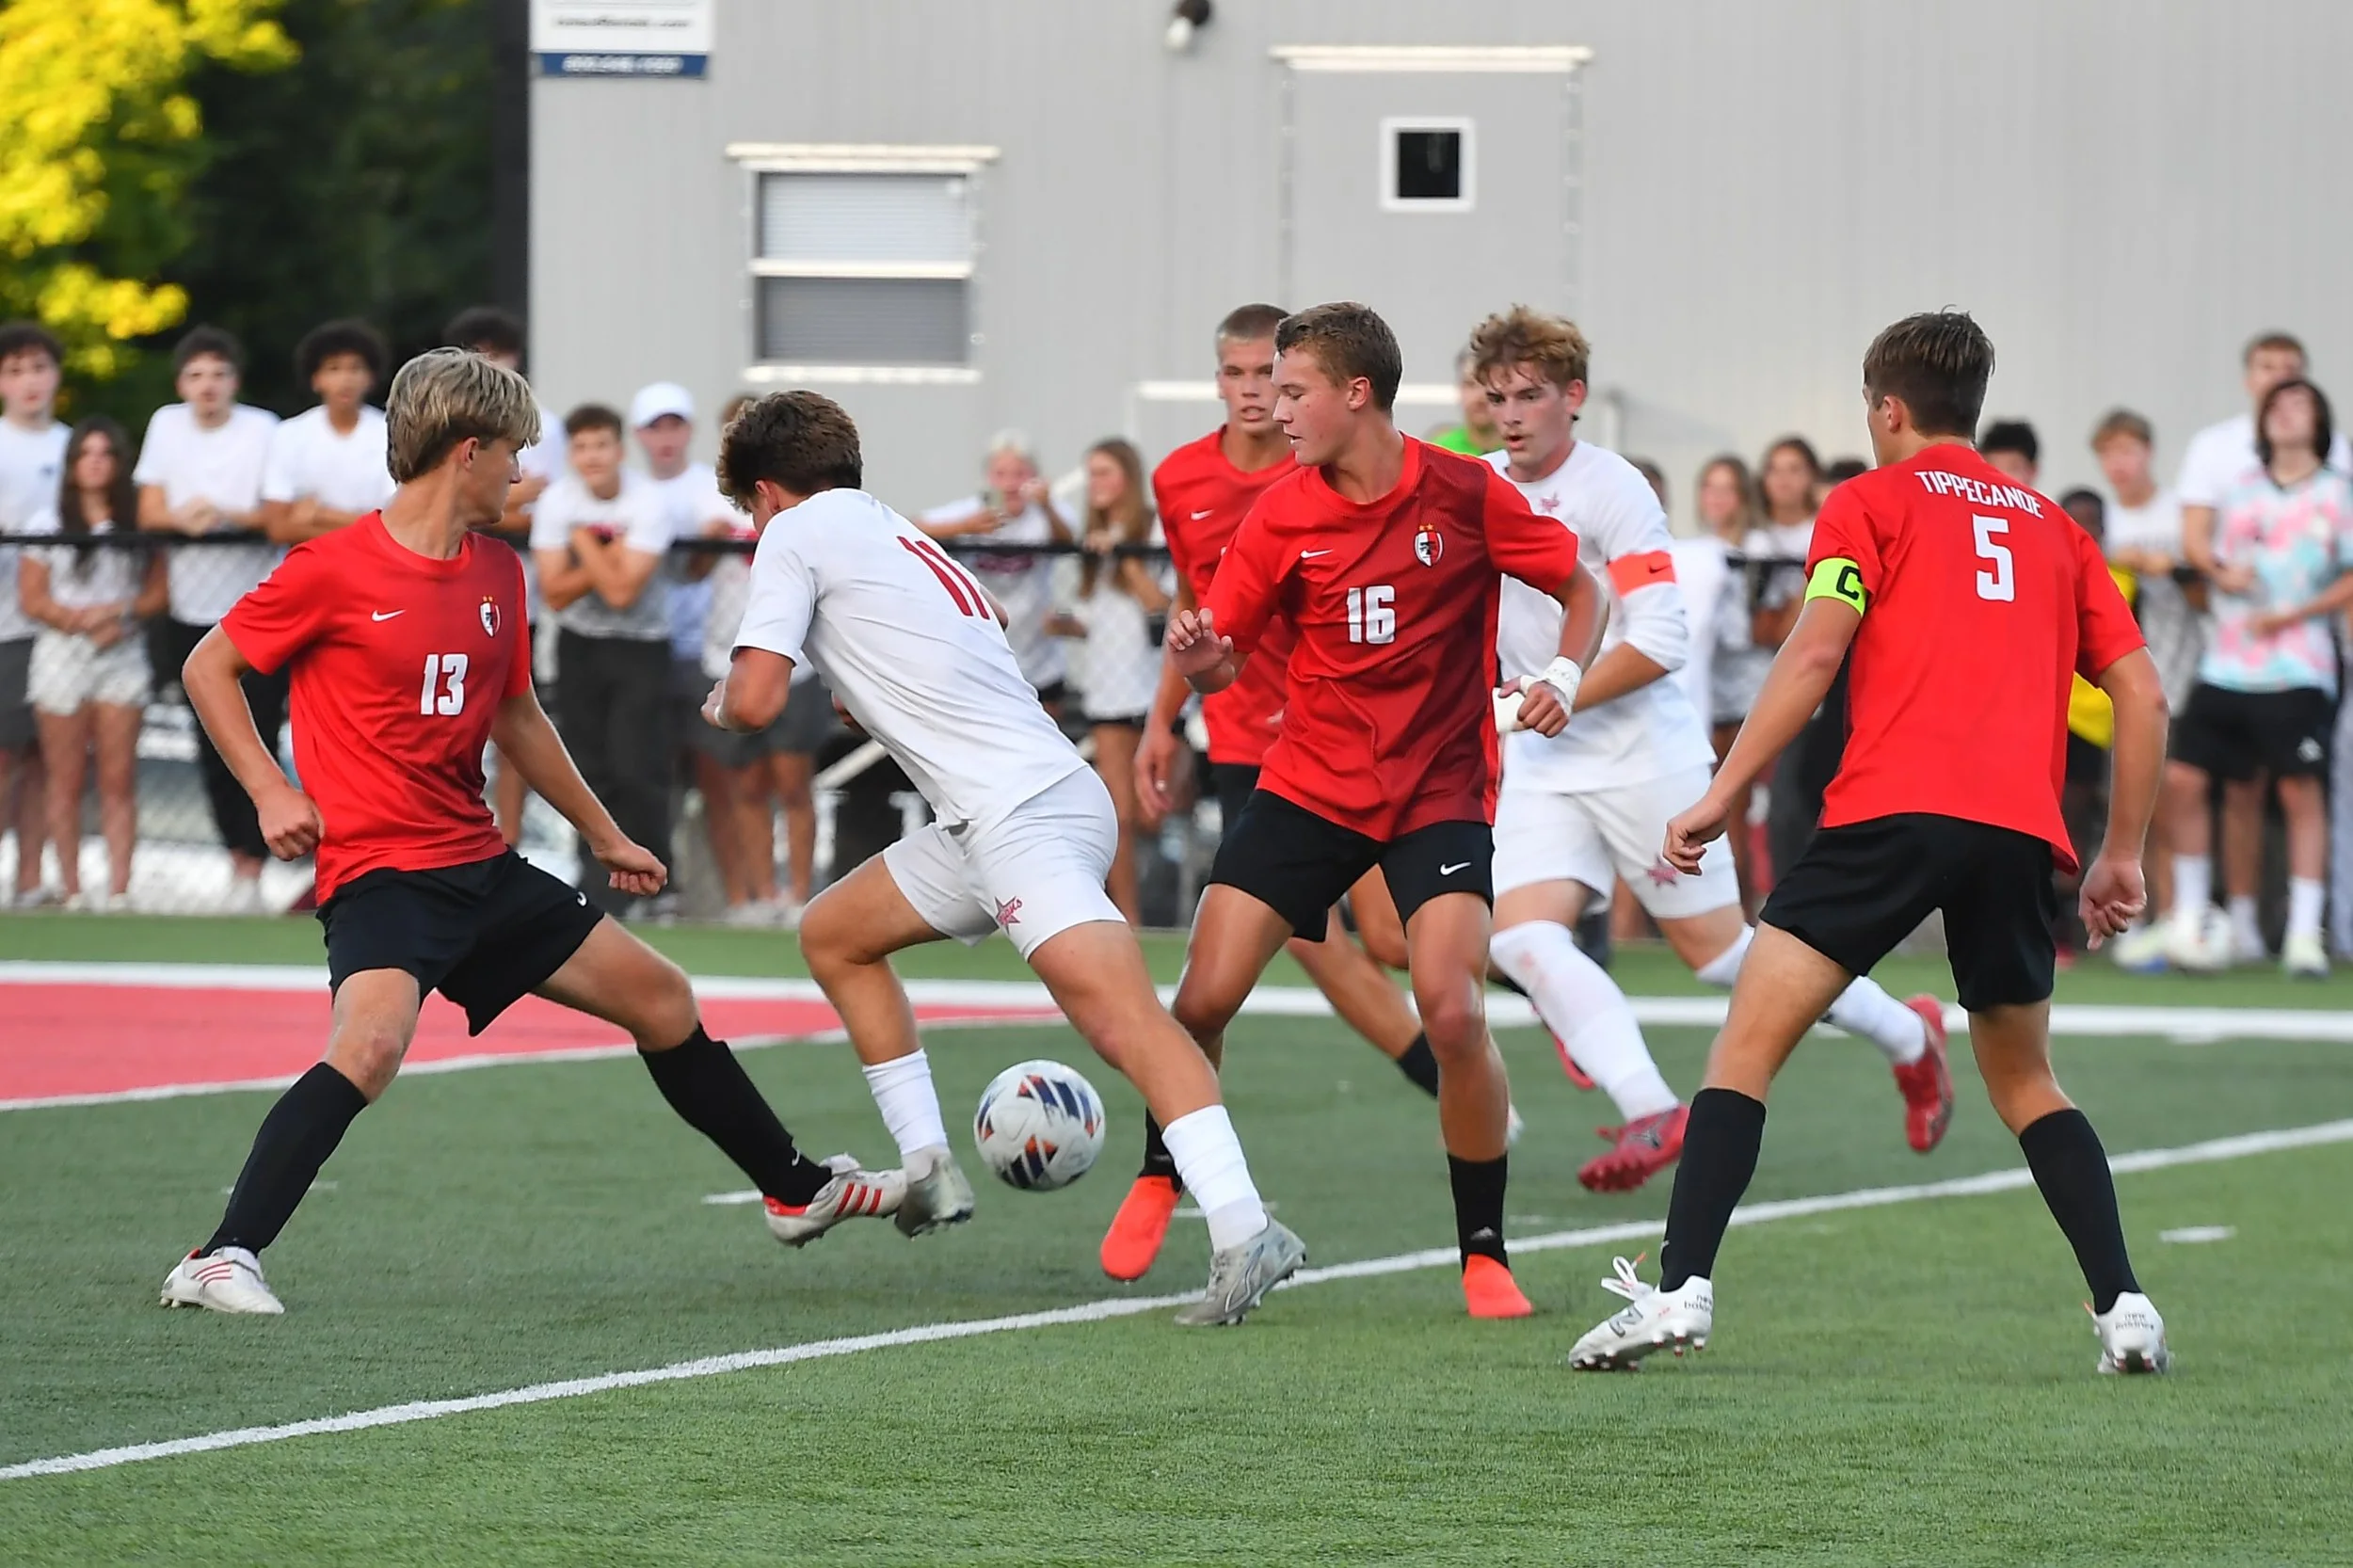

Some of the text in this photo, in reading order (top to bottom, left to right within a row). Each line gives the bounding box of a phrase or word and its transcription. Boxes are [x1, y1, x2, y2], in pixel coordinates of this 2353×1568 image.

[1913, 470, 2044, 520] TIPPECANOE
[896, 536, 990, 620] 11
[1835, 565, 1863, 600] C
[1972, 512, 2015, 602] 5
[1346, 584, 1396, 645] 16
[420, 653, 469, 716] 13
